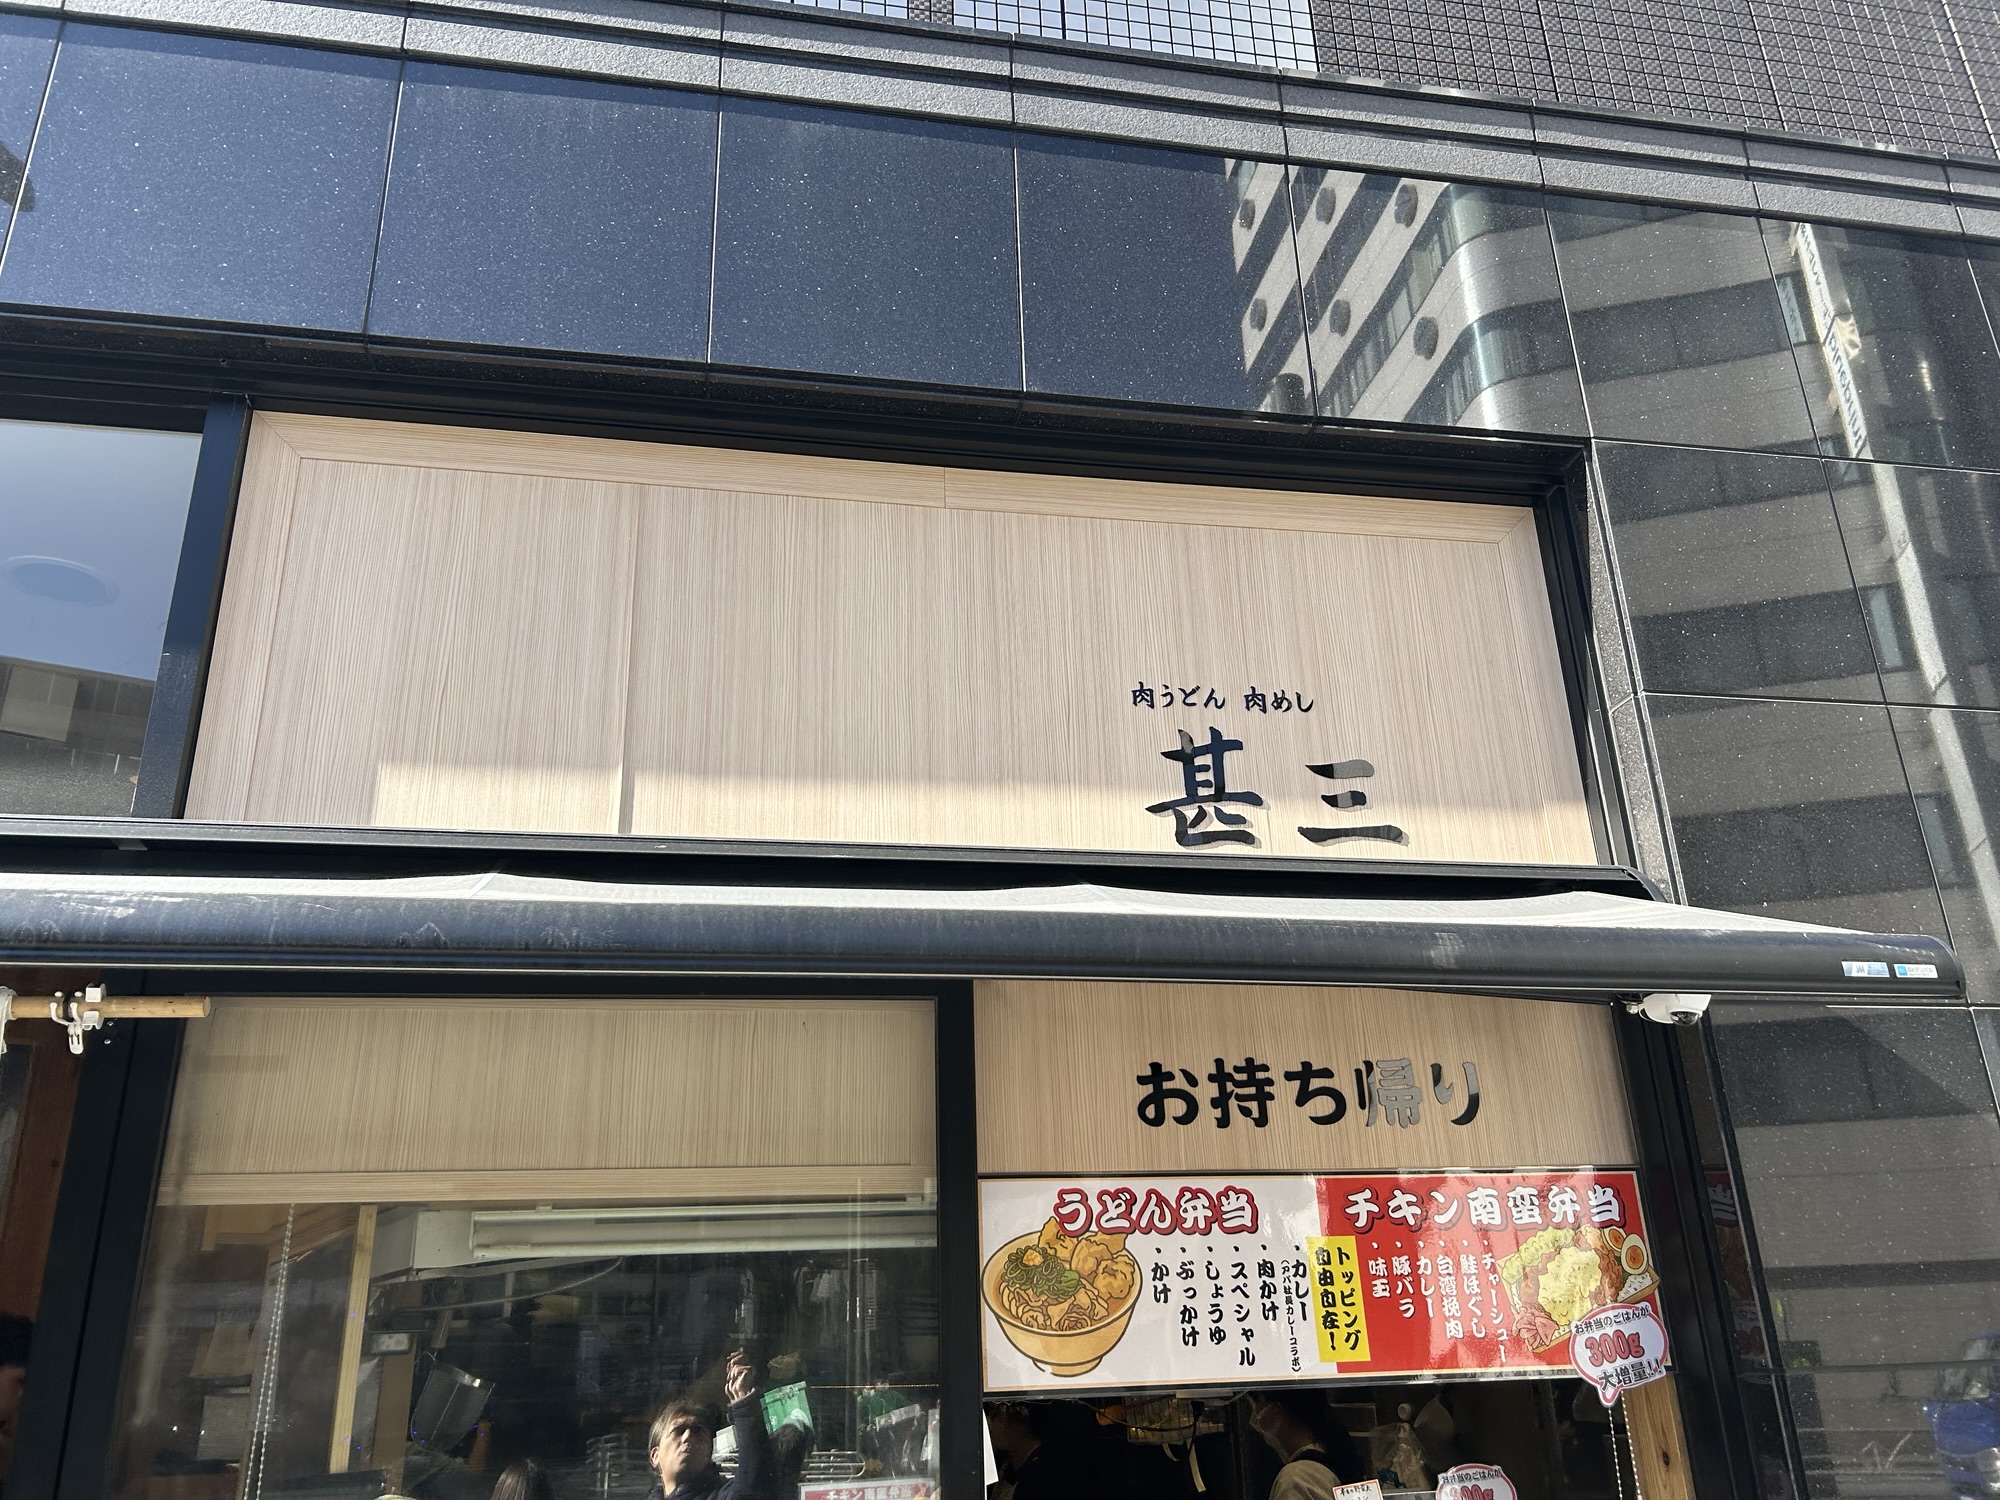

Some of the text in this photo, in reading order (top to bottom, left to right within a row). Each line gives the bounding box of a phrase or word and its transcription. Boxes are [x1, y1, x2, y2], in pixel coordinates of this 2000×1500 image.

[1131, 681, 1313, 714] 肉うどん 肉めし
[1136, 1057, 1480, 1129] お持ち帰り
[1053, 1185, 1259, 1238] うどん弁当
[1343, 1184, 1624, 1233] チキン南蛮弁当
[1337, 1247, 1362, 1351] トッピング
[1574, 1304, 1651, 1334] お弁当のごはんが
[1585, 1329, 1645, 1367] 300g
[1441, 1467, 1502, 1485] お弁当のごはんが
